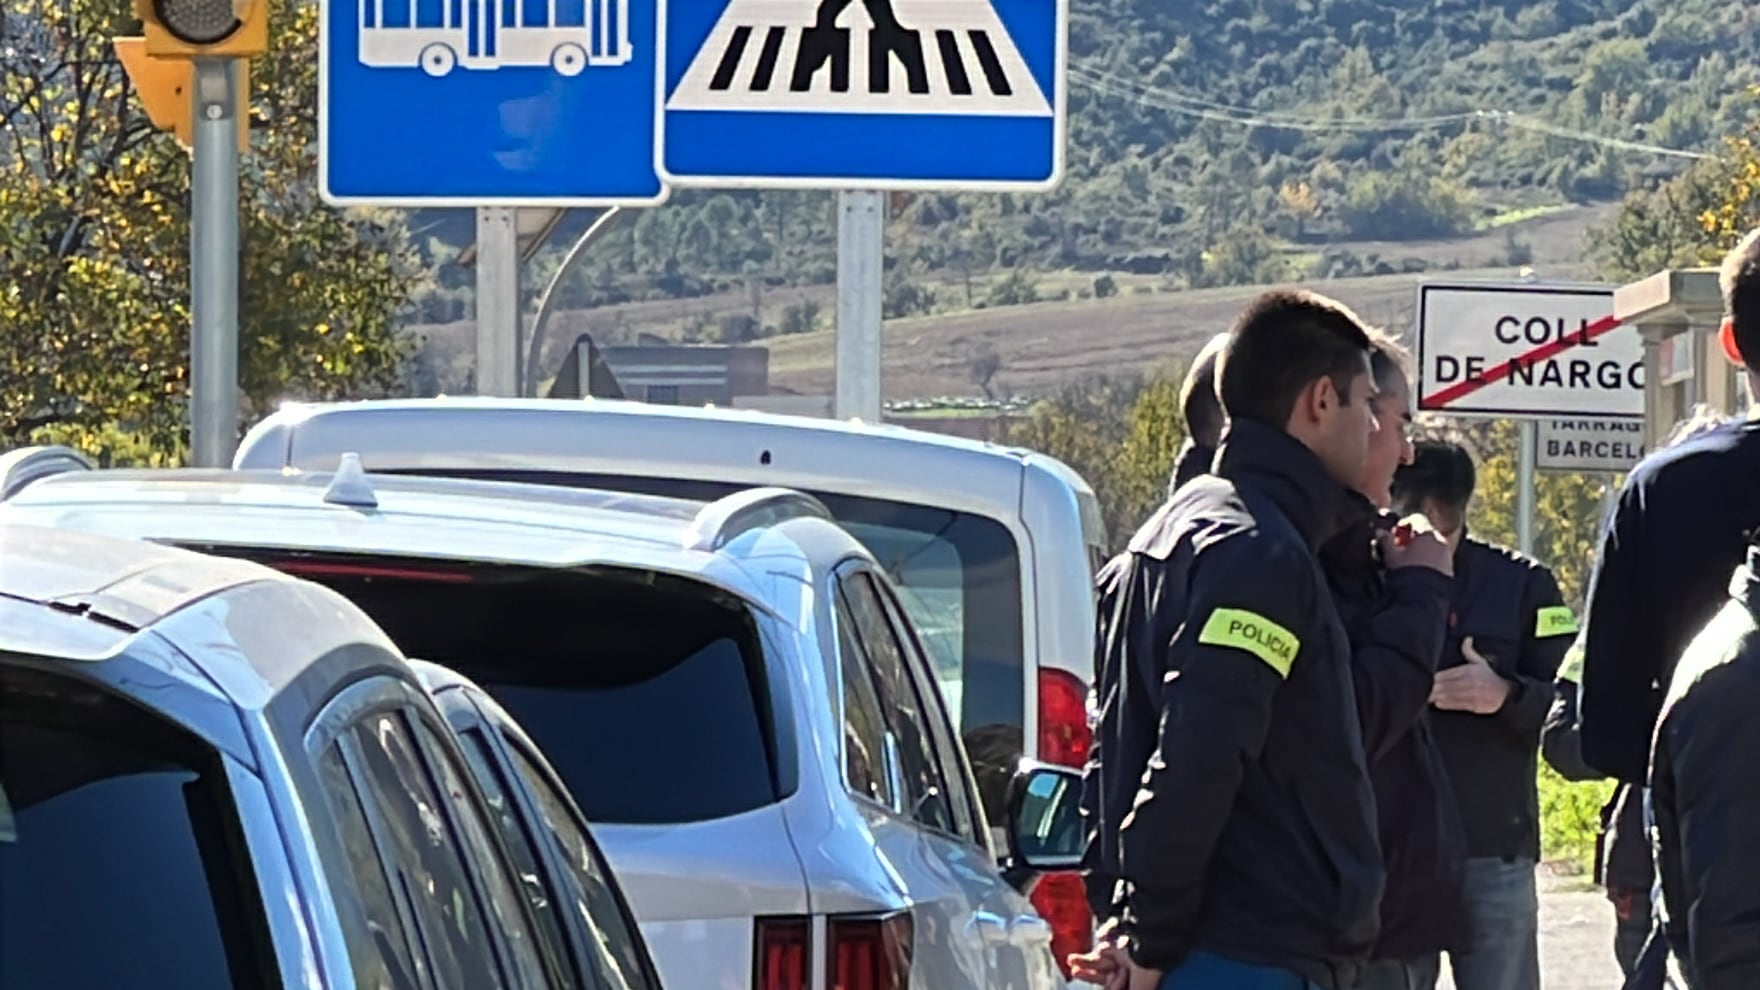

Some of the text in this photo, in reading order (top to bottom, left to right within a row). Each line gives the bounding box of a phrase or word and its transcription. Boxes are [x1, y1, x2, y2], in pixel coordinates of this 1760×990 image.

[1495, 316, 1598, 347] COLL
[1435, 355, 1486, 384] DE
[1228, 620, 1291, 659] POLICIA
